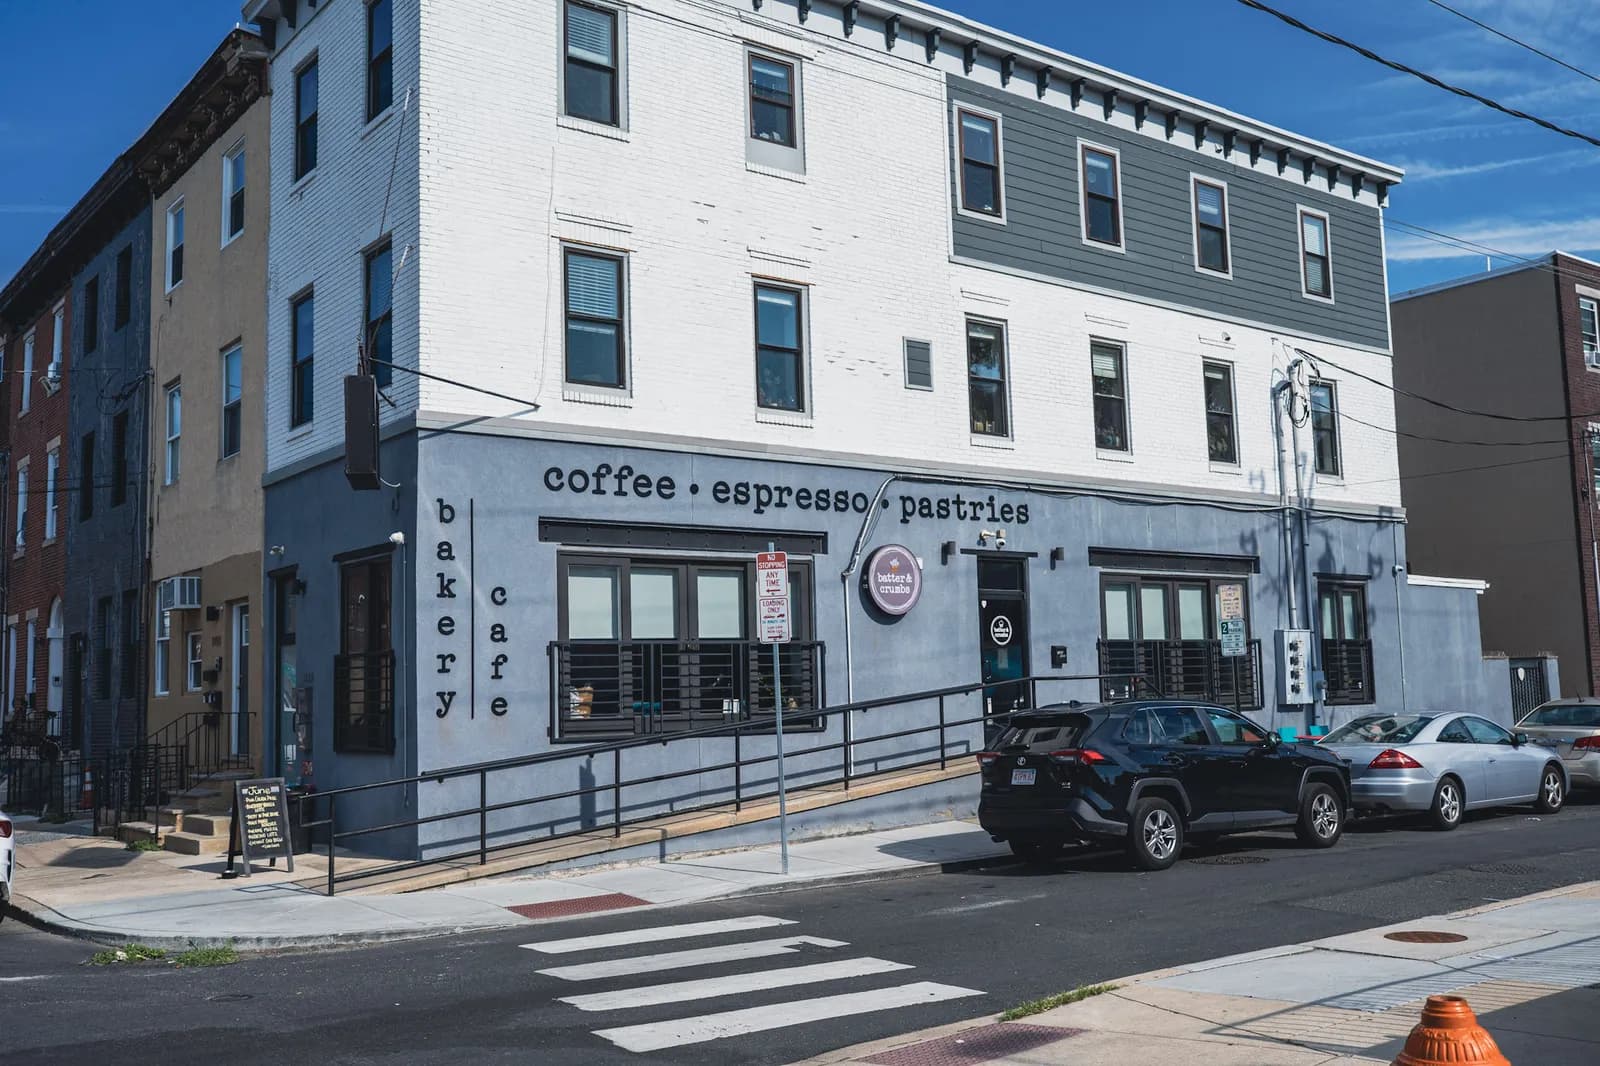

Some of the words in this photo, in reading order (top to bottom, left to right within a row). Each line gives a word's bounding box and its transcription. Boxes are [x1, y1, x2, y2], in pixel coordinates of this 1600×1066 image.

[543, 463, 676, 500] coffee
[712, 480, 869, 515] espresso
[899, 493, 1030, 525] pastries
[758, 562, 786, 570] STOPPING
[766, 571, 779, 579] ANY
[877, 572, 905, 583] batter
[905, 573, 913, 583] &
[766, 579, 780, 587] TIME
[880, 584, 911, 594] crumbs
[436, 498, 457, 718] bakery
[762, 600, 785, 608] LOADING
[1222, 623, 1228, 633] 2
[490, 586, 508, 717] cafe
